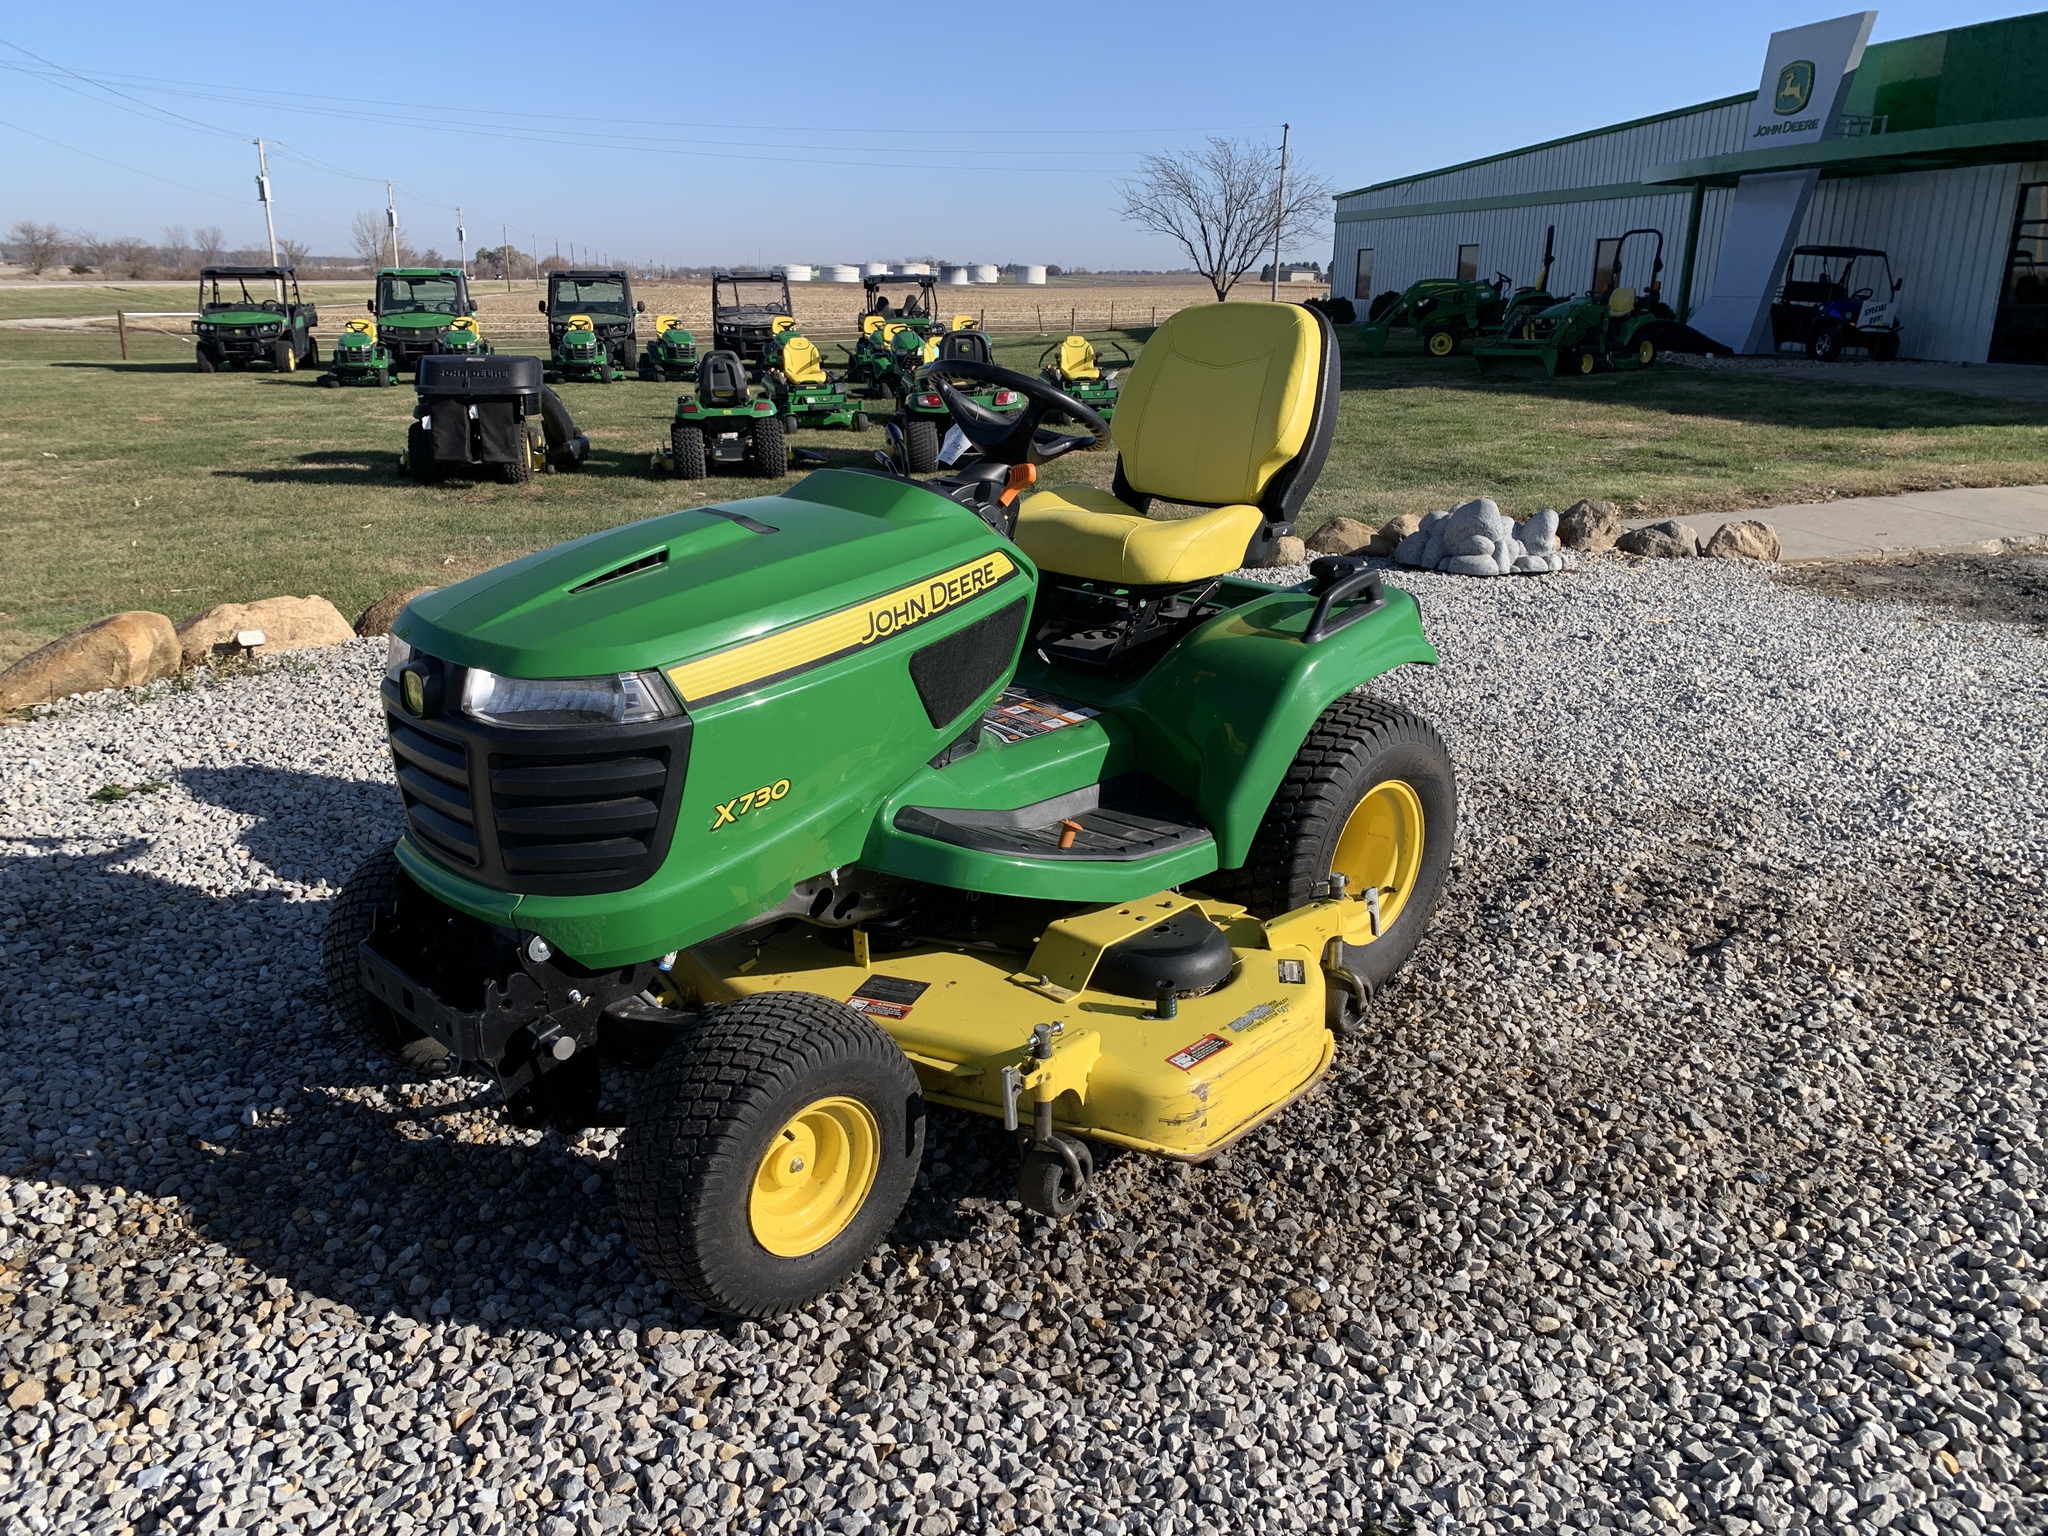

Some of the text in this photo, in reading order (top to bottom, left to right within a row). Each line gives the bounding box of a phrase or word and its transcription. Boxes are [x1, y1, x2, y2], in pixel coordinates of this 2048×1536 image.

[1753, 118, 1820, 138] JOHN DEERE
[1864, 303, 1888, 317] SPECIAL
[439, 369, 509, 378] JOHN DEERE
[861, 561, 996, 642] JOHN DEERE
[709, 778, 791, 832] X730
